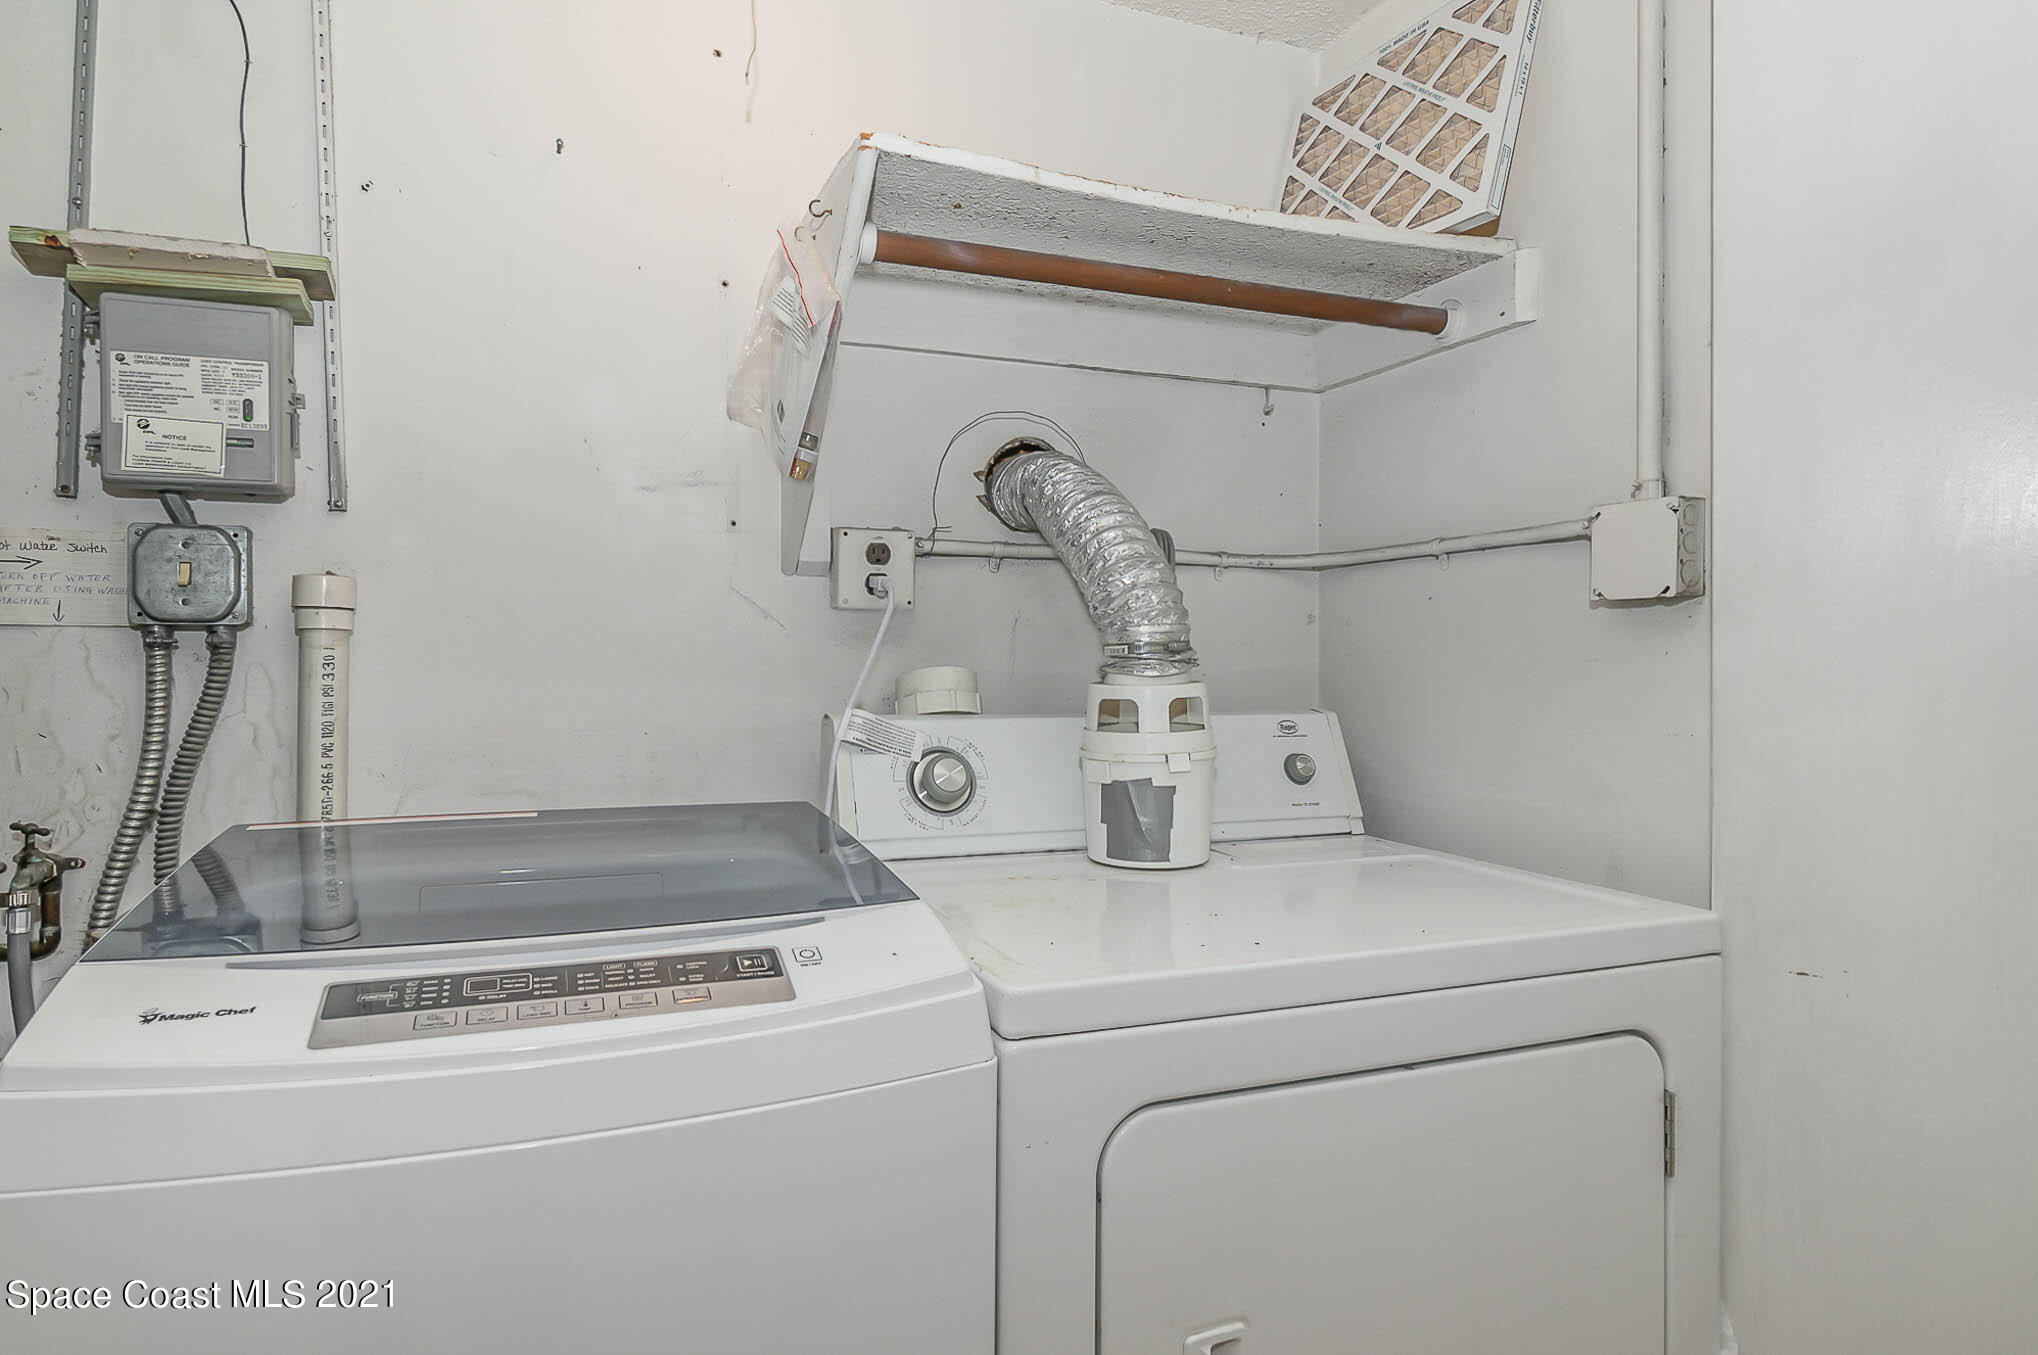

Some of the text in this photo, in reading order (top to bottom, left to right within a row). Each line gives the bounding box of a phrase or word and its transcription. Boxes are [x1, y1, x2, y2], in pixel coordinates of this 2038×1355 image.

[65, 573, 111, 582] WATER
[321, 655, 336, 682] 330
[158, 1006, 256, 1022] Magic Chef
